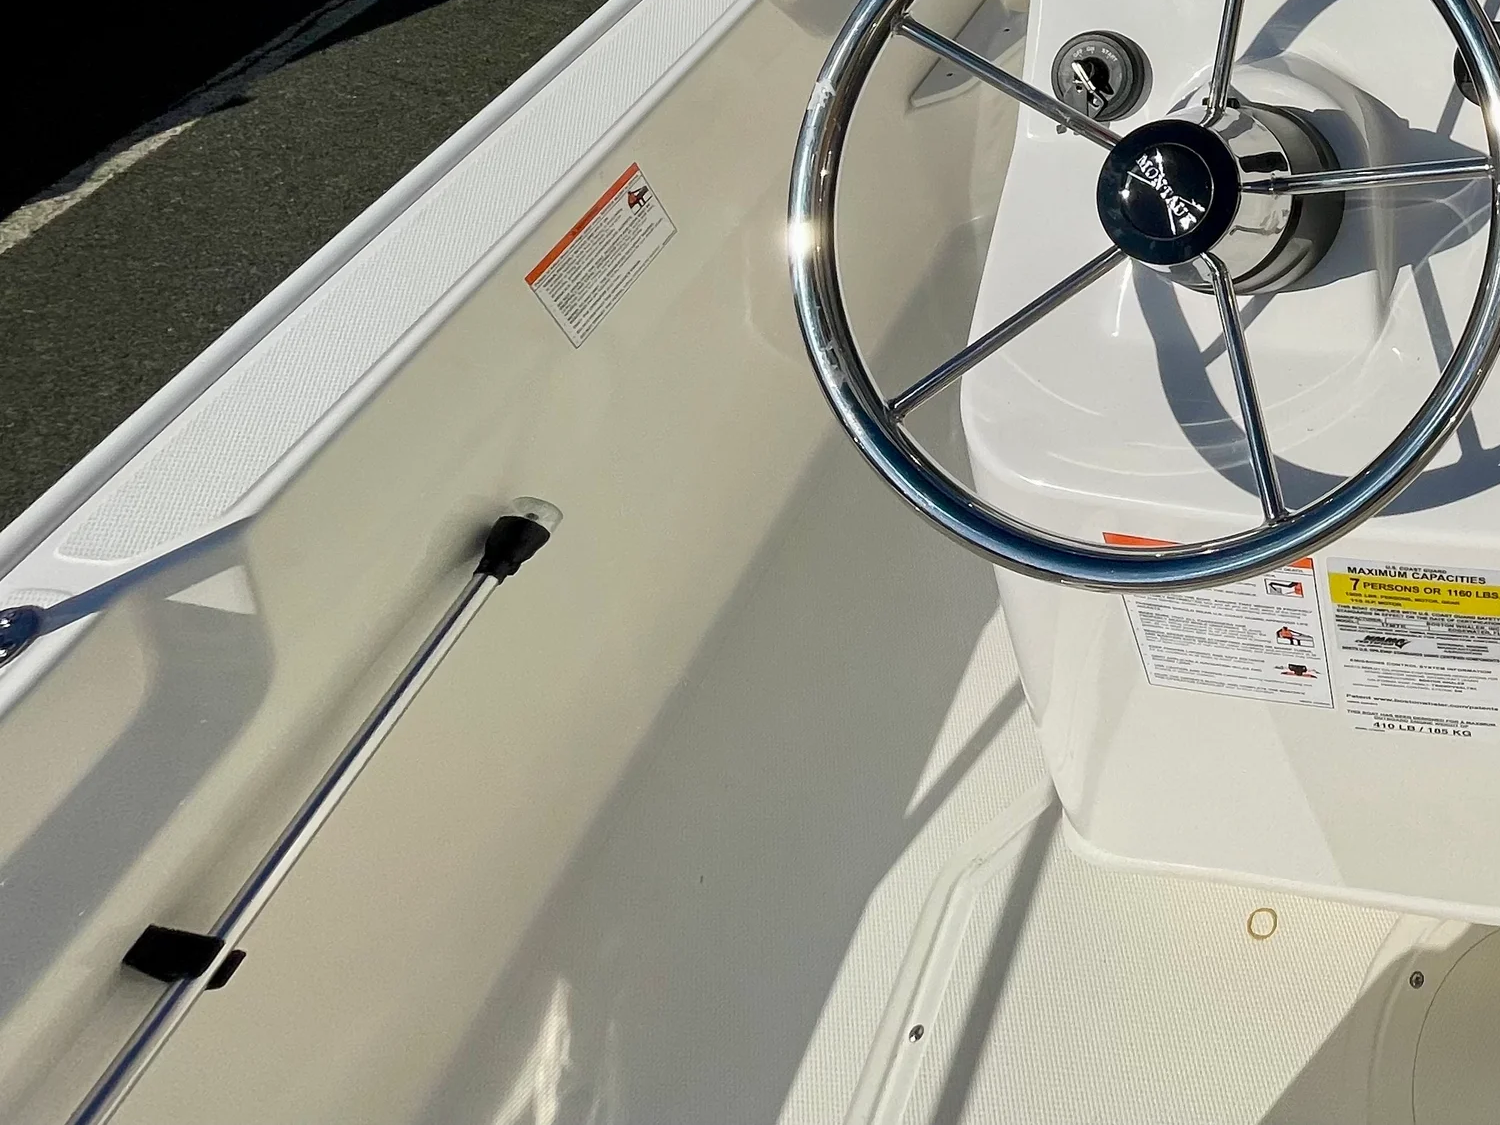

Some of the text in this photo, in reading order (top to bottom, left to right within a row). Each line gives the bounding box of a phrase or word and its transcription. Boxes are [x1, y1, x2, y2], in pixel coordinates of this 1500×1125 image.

[1347, 566, 1486, 584] MAXIMUM CAPACITIES
[1349, 578, 1360, 591] 7
[1363, 582, 1420, 593] PERSONS
[1423, 587, 1441, 595] OR
[1447, 589, 1472, 597] 1160
